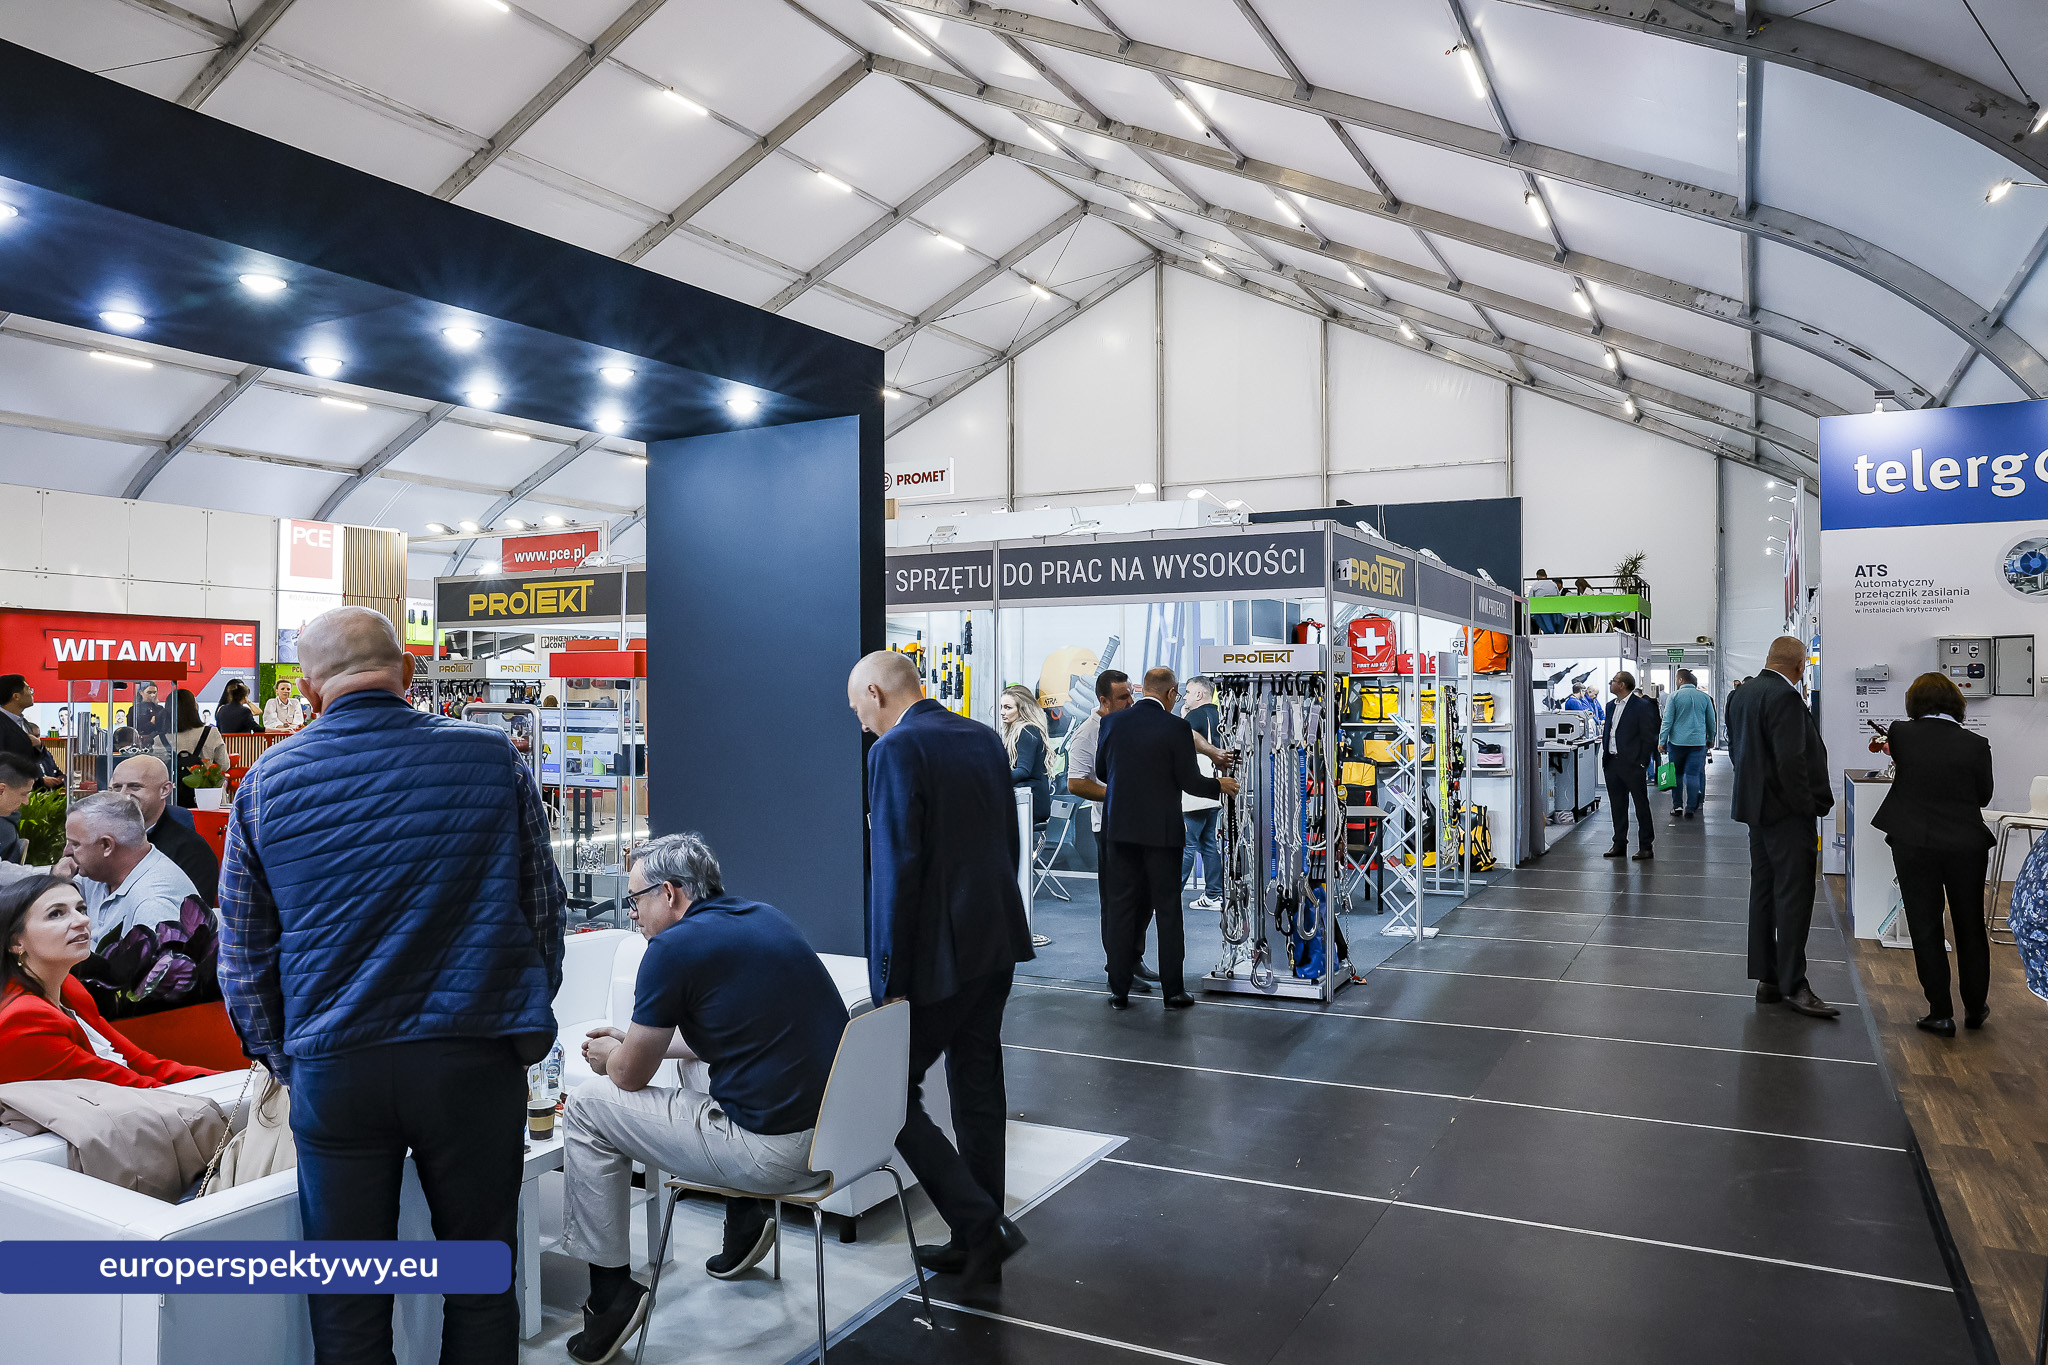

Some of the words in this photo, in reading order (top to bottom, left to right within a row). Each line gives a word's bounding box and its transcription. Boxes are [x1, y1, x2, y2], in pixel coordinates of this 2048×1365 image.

[897, 470, 945, 486] PROMET
[292, 526, 332, 549] PCE
[514, 544, 585, 563] www.pce.pl
[896, 565, 991, 594] SPRZĘTU
[1004, 562, 1033, 586] DO
[1041, 559, 1102, 585] PRAC
[1111, 557, 1145, 581] NA
[1153, 544, 1306, 580] WYSOKOŚCI
[1337, 567, 1347, 578] 11
[1349, 554, 1406, 598] PROTEKT
[1855, 564, 1888, 577] ATS
[1855, 579, 1935, 589] Automatyczny
[468, 579, 595, 617] PROTEKT
[1855, 589, 1918, 600] przełącznik
[1921, 587, 1970, 597] zasilania
[1890, 598, 1920, 606] ciągłość
[1863, 606, 1904, 614] instalacjach
[1906, 605, 1950, 613] krytycznych
[224, 632, 253, 647] PCE
[52, 637, 196, 666] WITAMY!
[1223, 650, 1294, 664] PROTEKT
[439, 662, 473, 673] PROTEKT
[501, 663, 541, 673] PROTEKT
